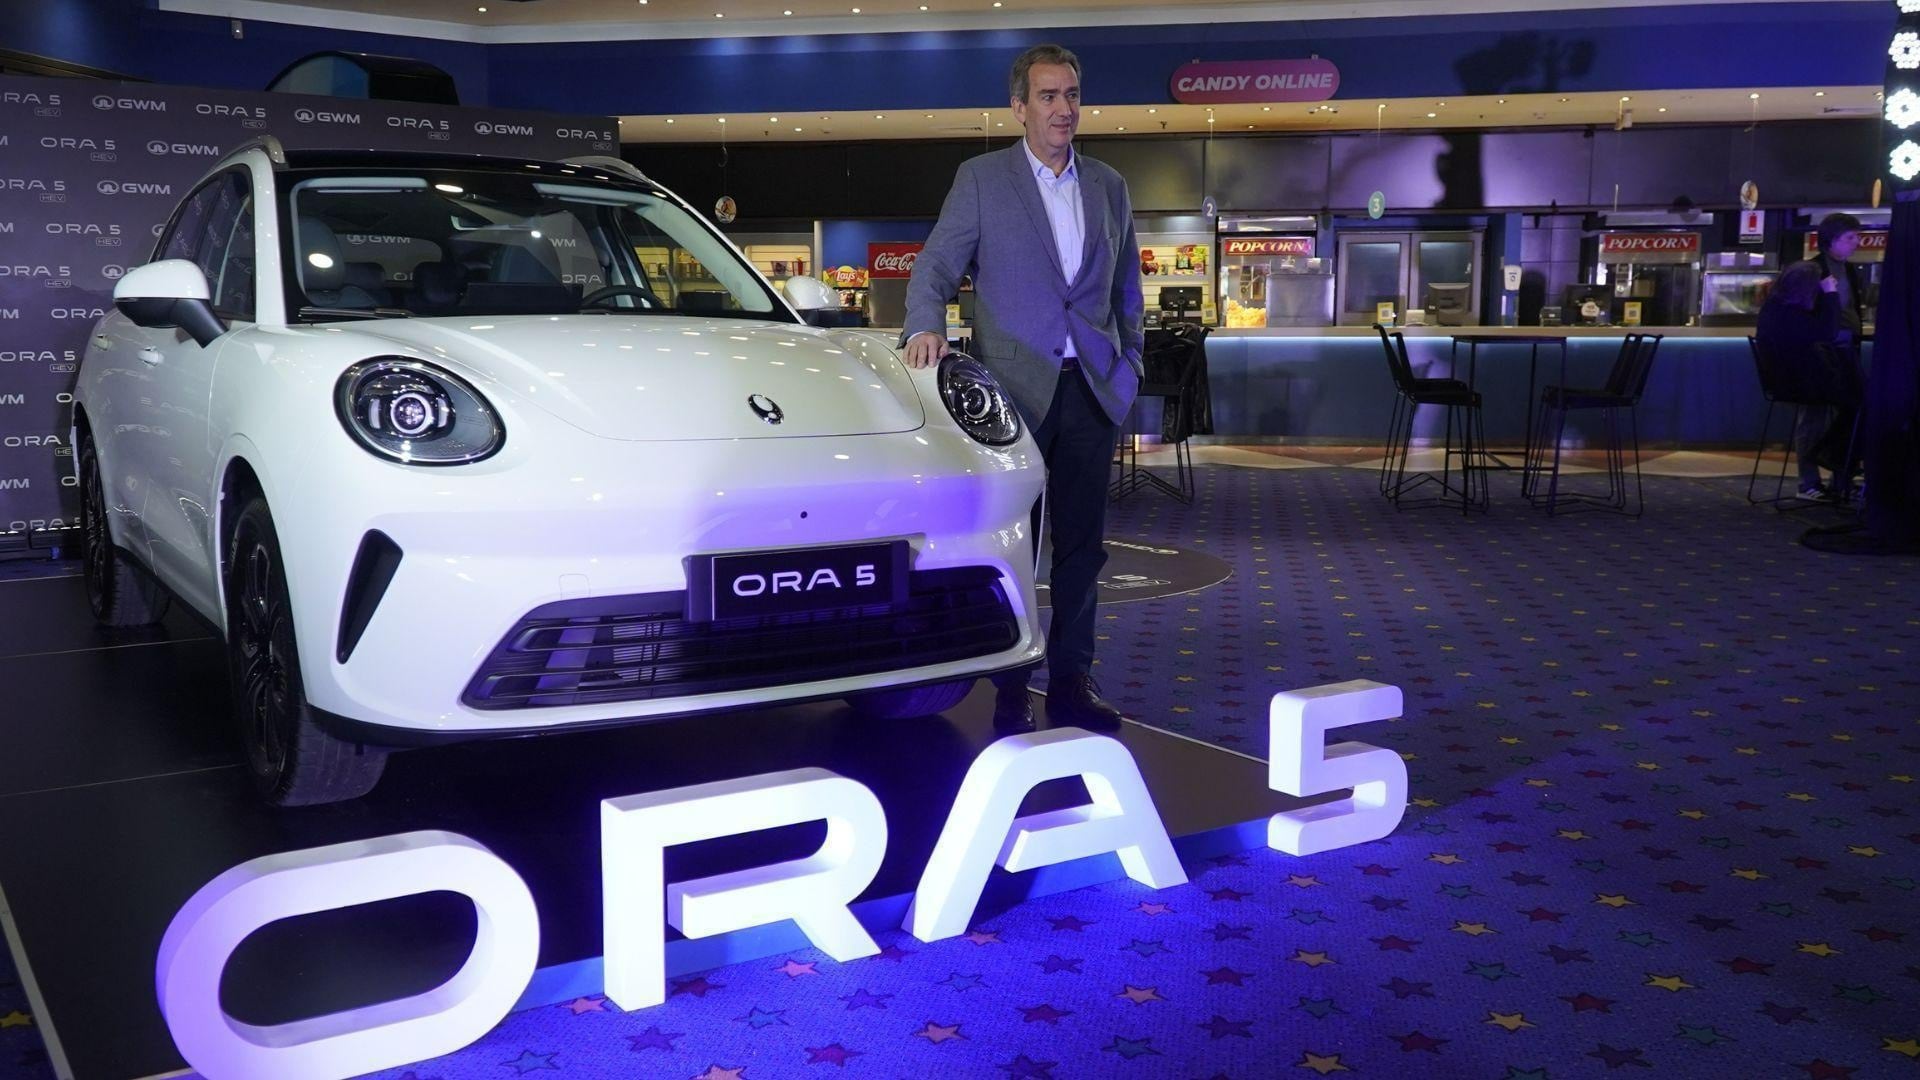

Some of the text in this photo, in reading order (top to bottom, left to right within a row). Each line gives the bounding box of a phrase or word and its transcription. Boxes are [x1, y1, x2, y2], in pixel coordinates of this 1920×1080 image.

[1177, 73, 1334, 92] CANDY ONLINE
[0, 92, 61, 105] RA 5
[117, 98, 166, 111] GWM
[196, 103, 267, 118] ORA 5
[316, 111, 360, 124] GWM
[386, 116, 450, 130] ORA 5
[494, 123, 533, 136] GWM
[556, 128, 612, 141] ORA 5
[40, 137, 116, 150] ORA 5
[171, 143, 219, 156] GWM
[54, 180, 66, 191] 5
[122, 183, 171, 195] GWM
[1206, 202, 1214, 217] 2
[1372, 198, 1380, 212] 3
[46, 223, 121, 235] ORA 5
[97, 238, 121, 246] HEV
[368, 234, 410, 244] GWM
[548, 238, 576, 247] WM
[1607, 237, 1692, 249] POPCORN
[1228, 241, 1306, 253] POPCORN
[874, 252, 918, 271] Coca-Co
[59, 266, 71, 277] 5
[51, 308, 105, 319] ORA
[0, 350, 76, 361] ORA 5
[51, 364, 76, 372] HEV
[4, 435, 62, 446] ORA
[9, 518, 65, 531] ORA
[732, 564, 876, 597] ORA 5
[156, 678, 1409, 1080] ORA 5
